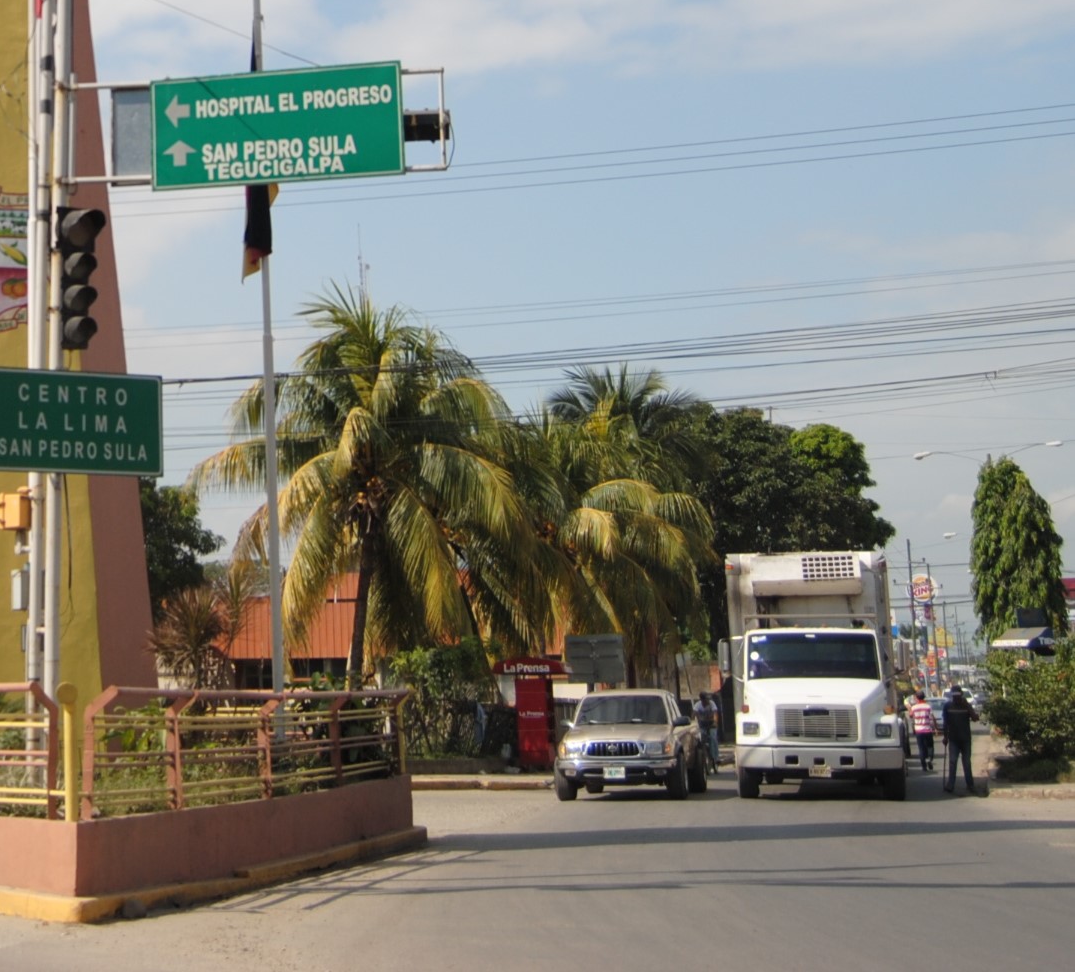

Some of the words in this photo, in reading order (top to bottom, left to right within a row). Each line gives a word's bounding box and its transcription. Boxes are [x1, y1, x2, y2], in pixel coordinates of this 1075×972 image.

[195, 95, 274, 119] HOSPITAL
[278, 92, 299, 113] EL
[302, 84, 392, 110] PROGRESO
[201, 142, 238, 164] SAN
[242, 138, 303, 161] PEDRO
[307, 134, 357, 157] SULA
[204, 155, 344, 180] TEGUCIGALPA
[18, 383, 128, 406] CENTRO
[18, 411, 48, 430] LA
[64, 413, 127, 433] LIMA
[38, 440, 98, 460] PEDRO
[103, 443, 148, 462] SULA
[503, 663, 515, 673] La
[516, 663, 550, 673] Prensa
